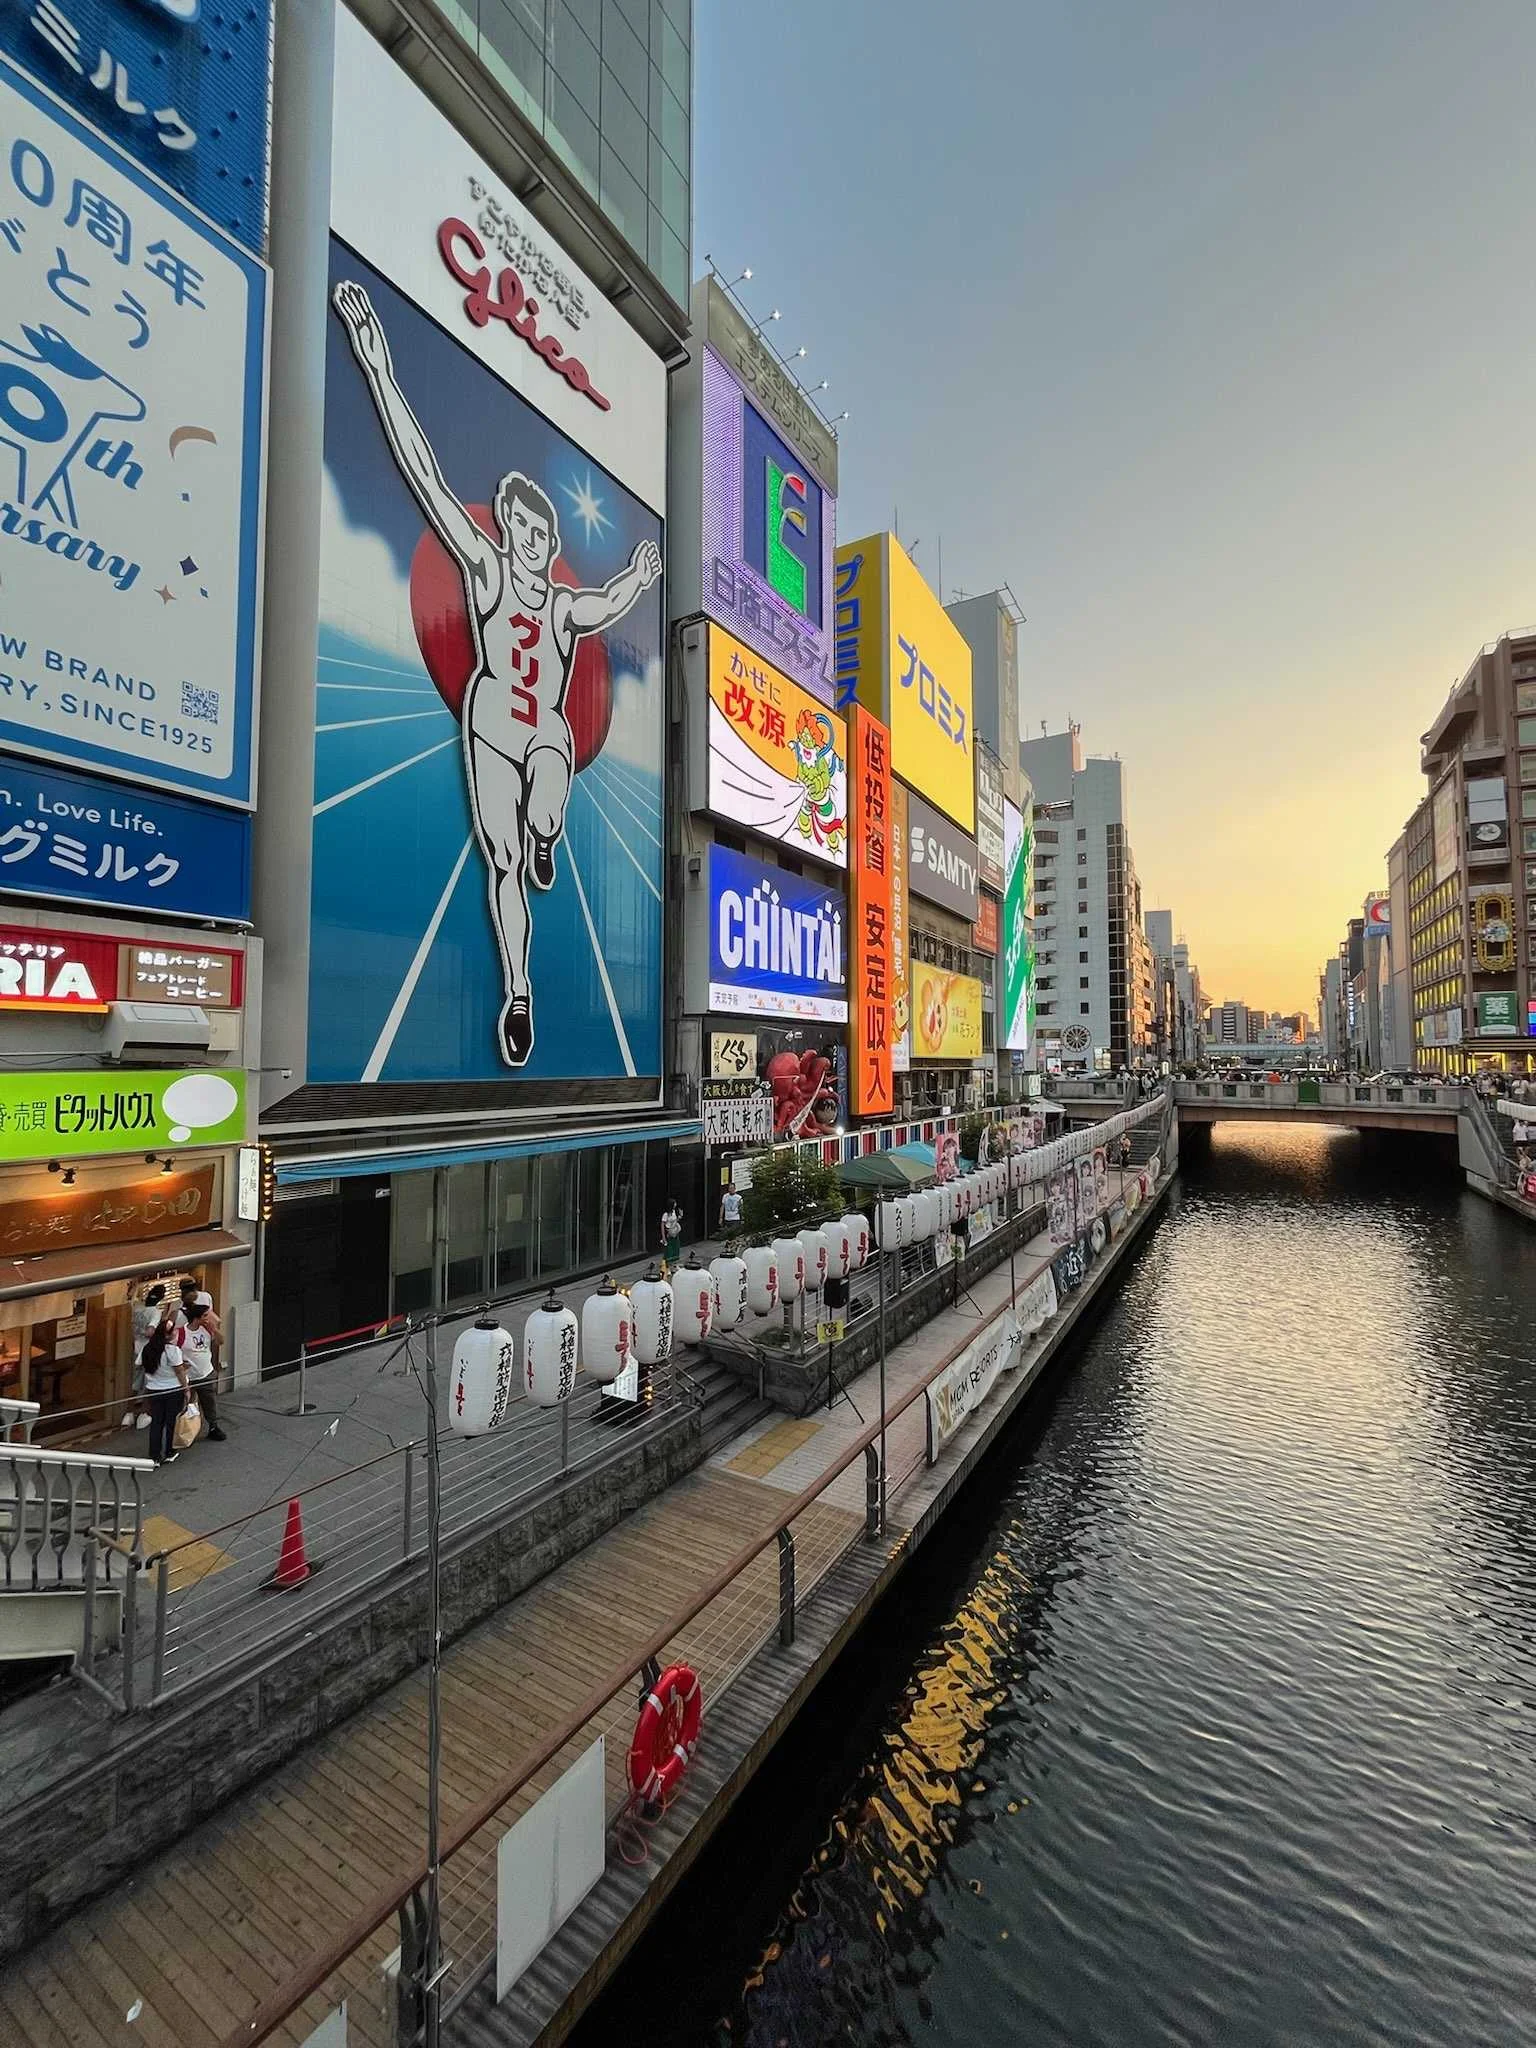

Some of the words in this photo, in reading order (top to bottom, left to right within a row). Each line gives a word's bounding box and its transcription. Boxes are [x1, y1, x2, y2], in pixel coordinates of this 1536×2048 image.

[436, 216, 613, 412] Glico
[834, 552, 867, 712] プロミス
[44, 648, 156, 702] BRAND
[508, 611, 543, 729] グリコ
[730, 650, 782, 706] かぜに
[897, 632, 969, 758] プロミス
[723, 675, 787, 750] 改源
[38, 792, 102, 824] Love
[109, 808, 164, 837] Life.
[864, 721, 886, 877] 低投資
[0, 818, 180, 888] グミルク
[927, 836, 977, 896] SAMTY
[136, 971, 207, 985] フェアトレード
[138, 951, 223, 969] 絶品バーガー
[165, 985, 223, 1000] コーヒー
[864, 902, 887, 1106] 安定収入
[720, 1038, 749, 1072] くくる
[55, 1091, 157, 1134] ピタットハウス
[707, 1107, 766, 1137] 大阪に乾杯
